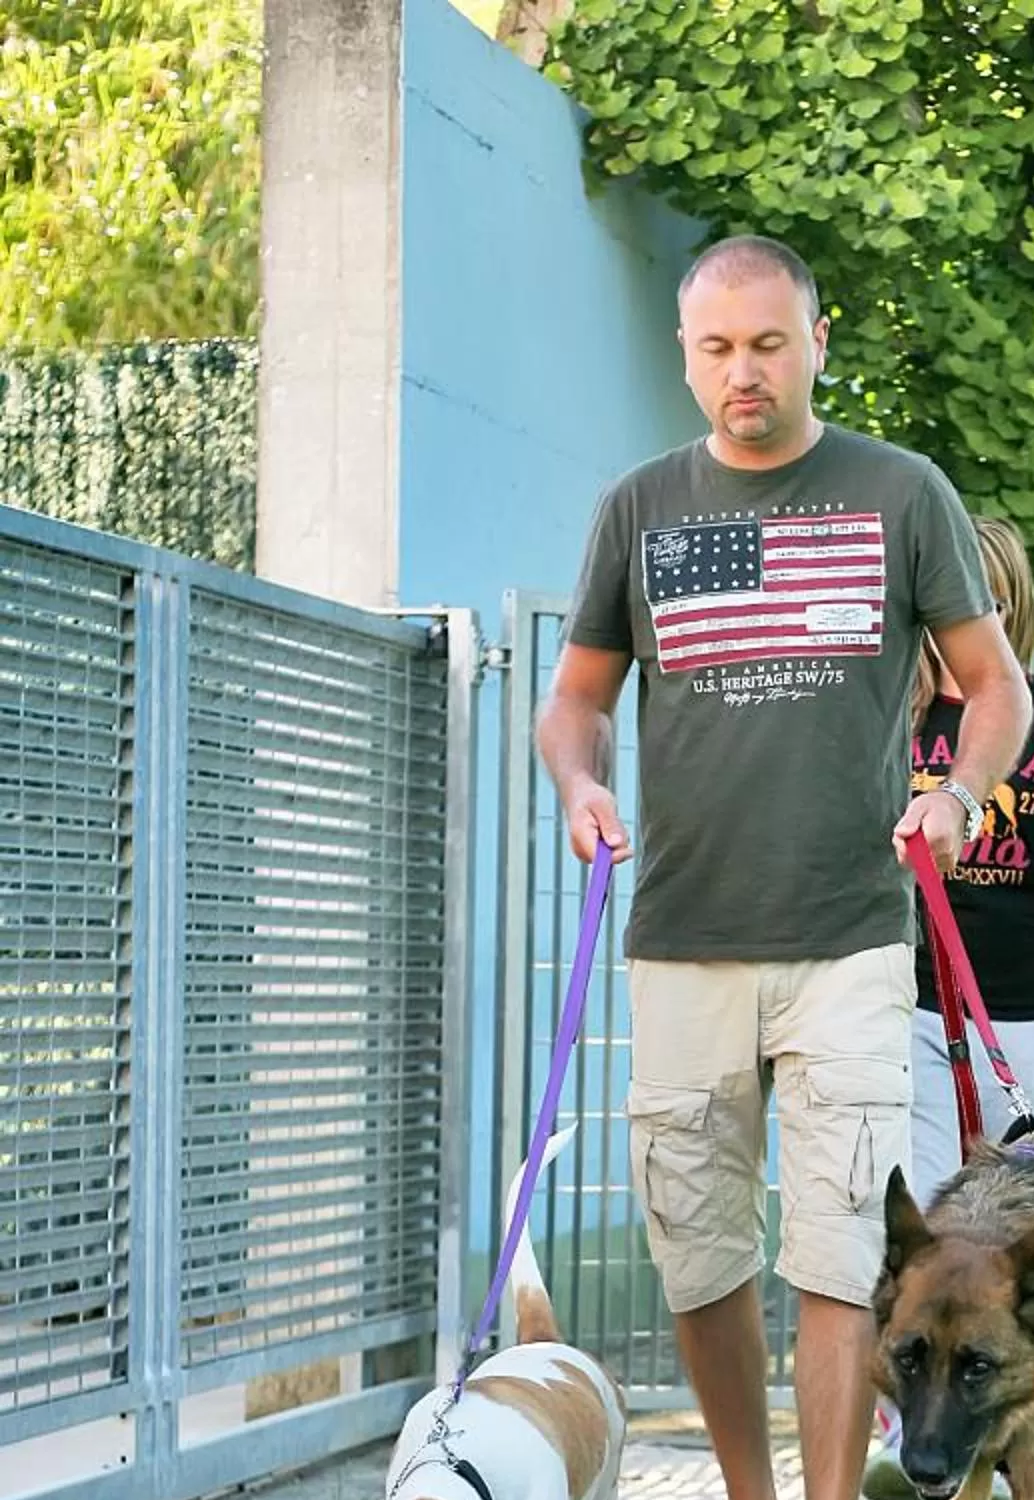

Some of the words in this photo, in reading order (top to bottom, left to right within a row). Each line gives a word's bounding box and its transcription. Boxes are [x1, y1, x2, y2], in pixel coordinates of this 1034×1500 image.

[744, 660, 831, 674] AMERICA
[693, 679, 719, 693] U.S.
[721, 672, 793, 691] HERITAGE
[795, 670, 845, 687] SW/75
